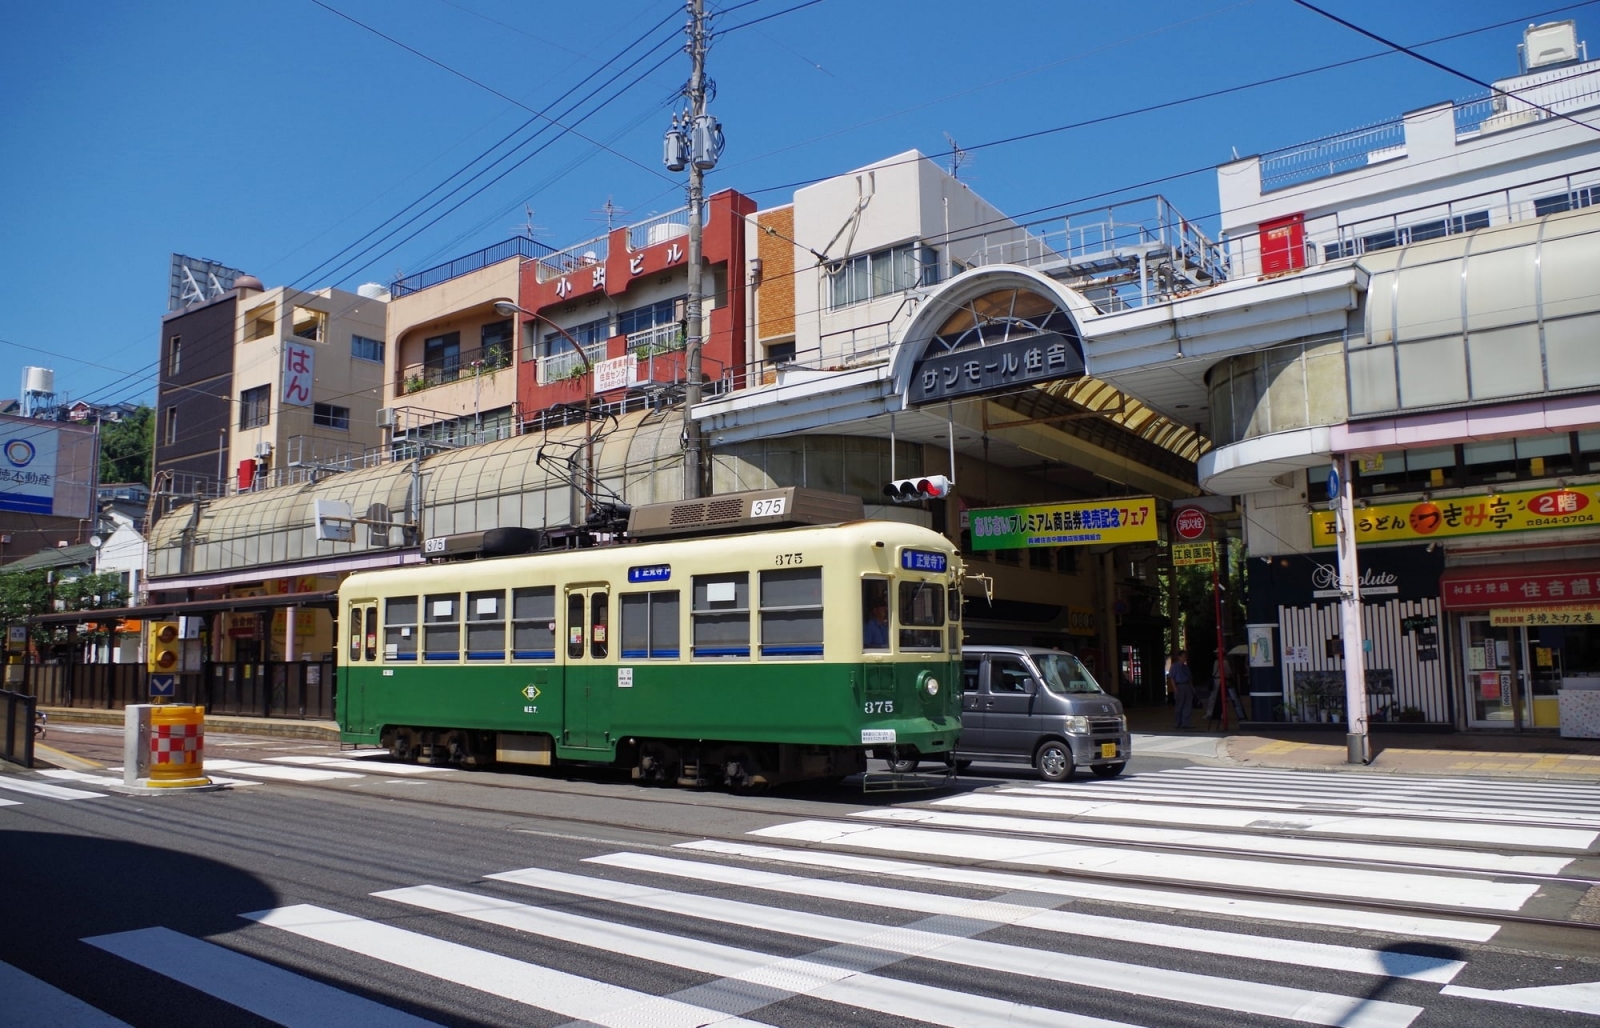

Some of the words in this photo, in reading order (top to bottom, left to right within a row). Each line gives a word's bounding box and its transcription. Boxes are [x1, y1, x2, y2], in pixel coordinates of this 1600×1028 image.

[556, 244, 683, 298] 小出ビル
[286, 346, 310, 402] はん
[921, 343, 1066, 390] サンモール住吉
[754, 499, 782, 516] 375
[1325, 515, 1406, 535] 五うどん
[1418, 497, 1513, 530] つきみ亭
[1538, 493, 1578, 514] 2階
[974, 506, 1149, 537] あじさいプレミアム商品券発売記念フェア
[1179, 517, 1203, 530] 消火栓
[1535, 514, 1594, 526] 844-0704
[427, 538, 443, 551] 375
[775, 552, 803, 566] 375
[903, 551, 912, 568] 1
[916, 554, 946, 569] 正覚寺下
[1174, 547, 1212, 560] 江良医院
[1312, 564, 1397, 589] Aolute
[1453, 582, 1509, 595] 和菓子饅頭
[1526, 612, 1594, 625] 手焼きカス巻
[864, 700, 894, 713] 375
